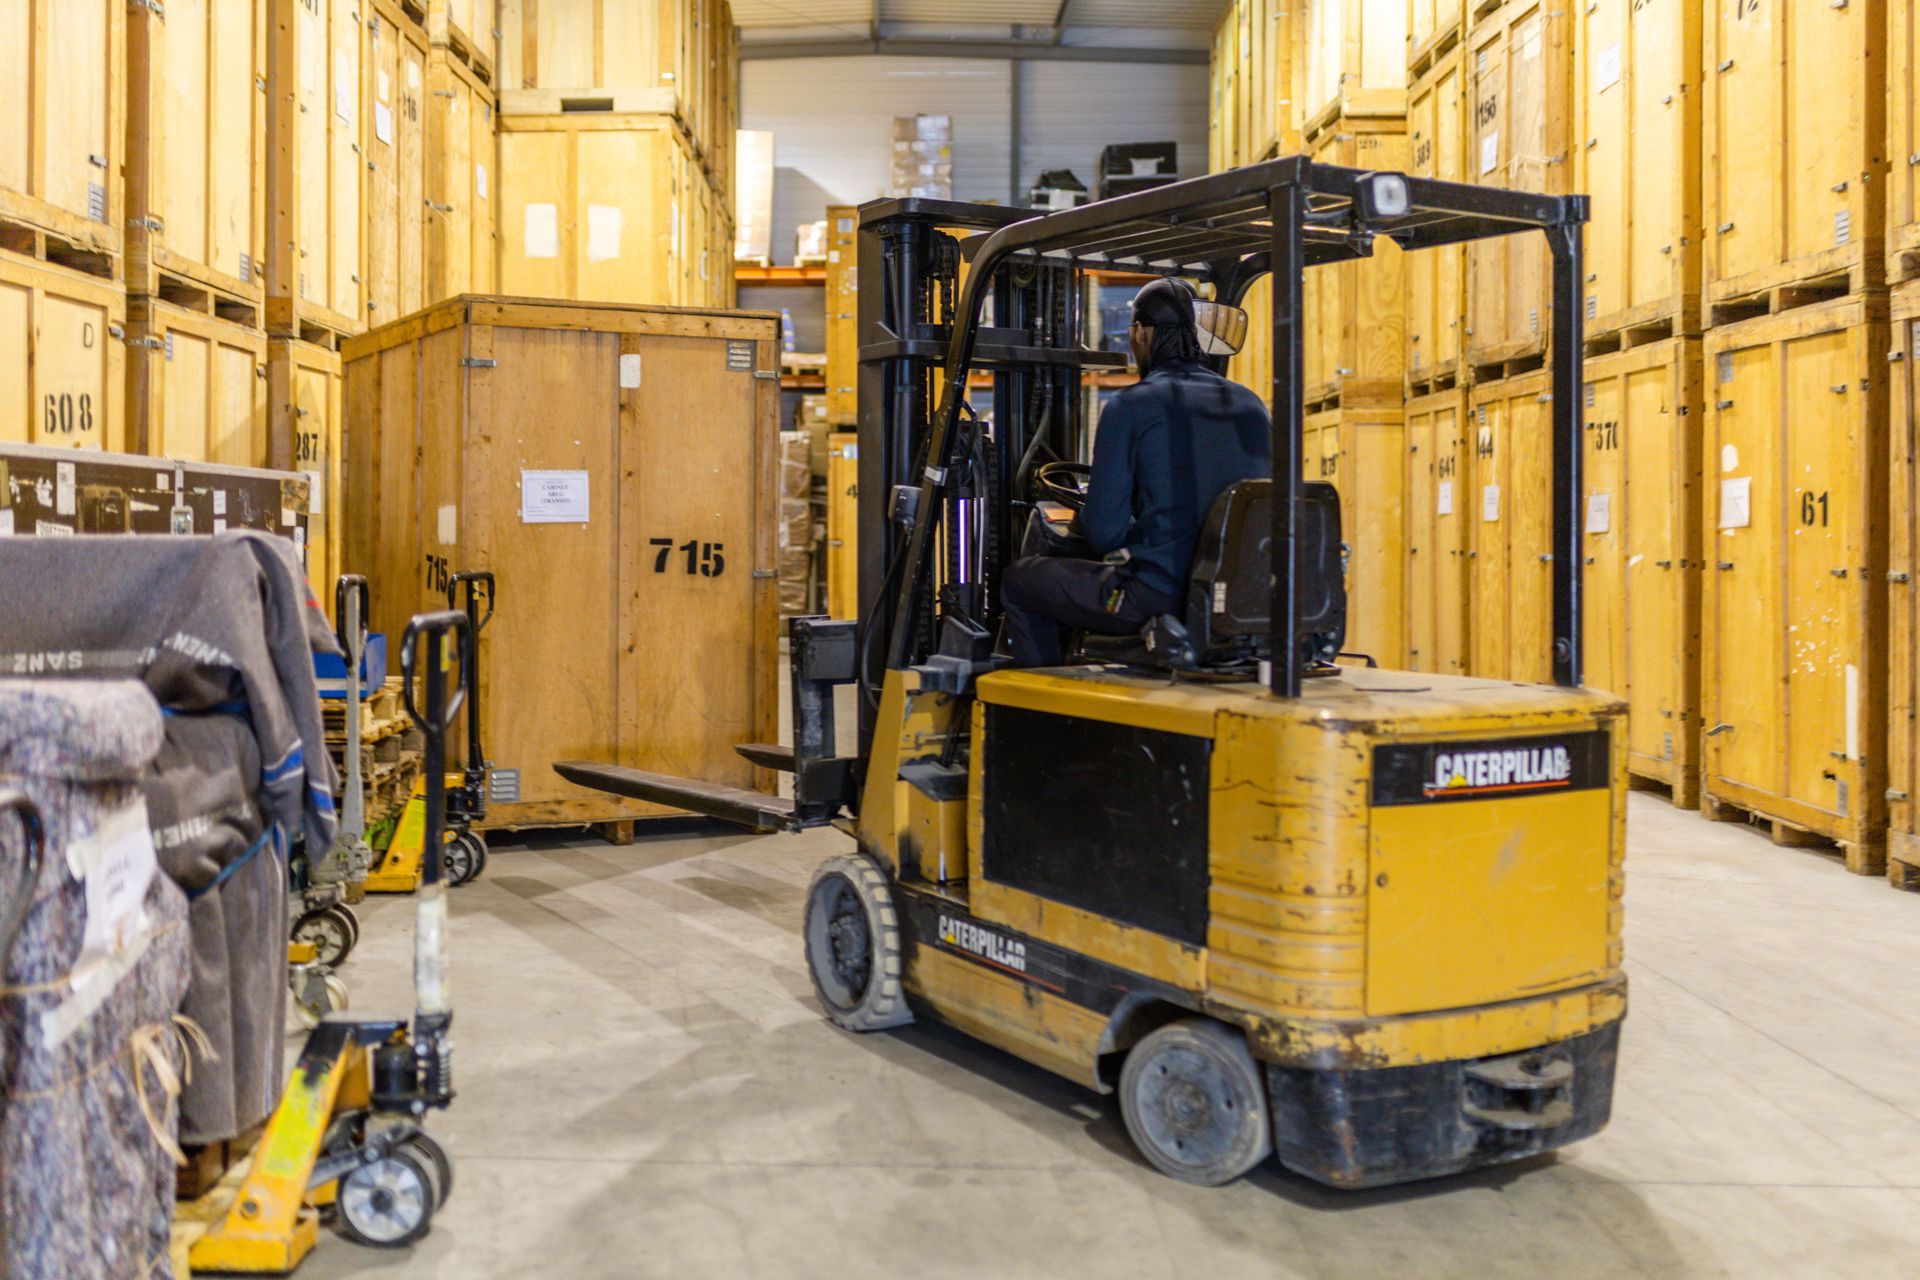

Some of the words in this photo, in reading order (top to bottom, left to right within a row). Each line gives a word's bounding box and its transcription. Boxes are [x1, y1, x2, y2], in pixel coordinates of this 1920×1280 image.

[44, 392, 93, 434] 608
[1801, 490, 1828, 528] 61
[425, 553, 449, 594] 715
[649, 537, 725, 578] 715
[938, 914, 1027, 973] CATERPILLAR
